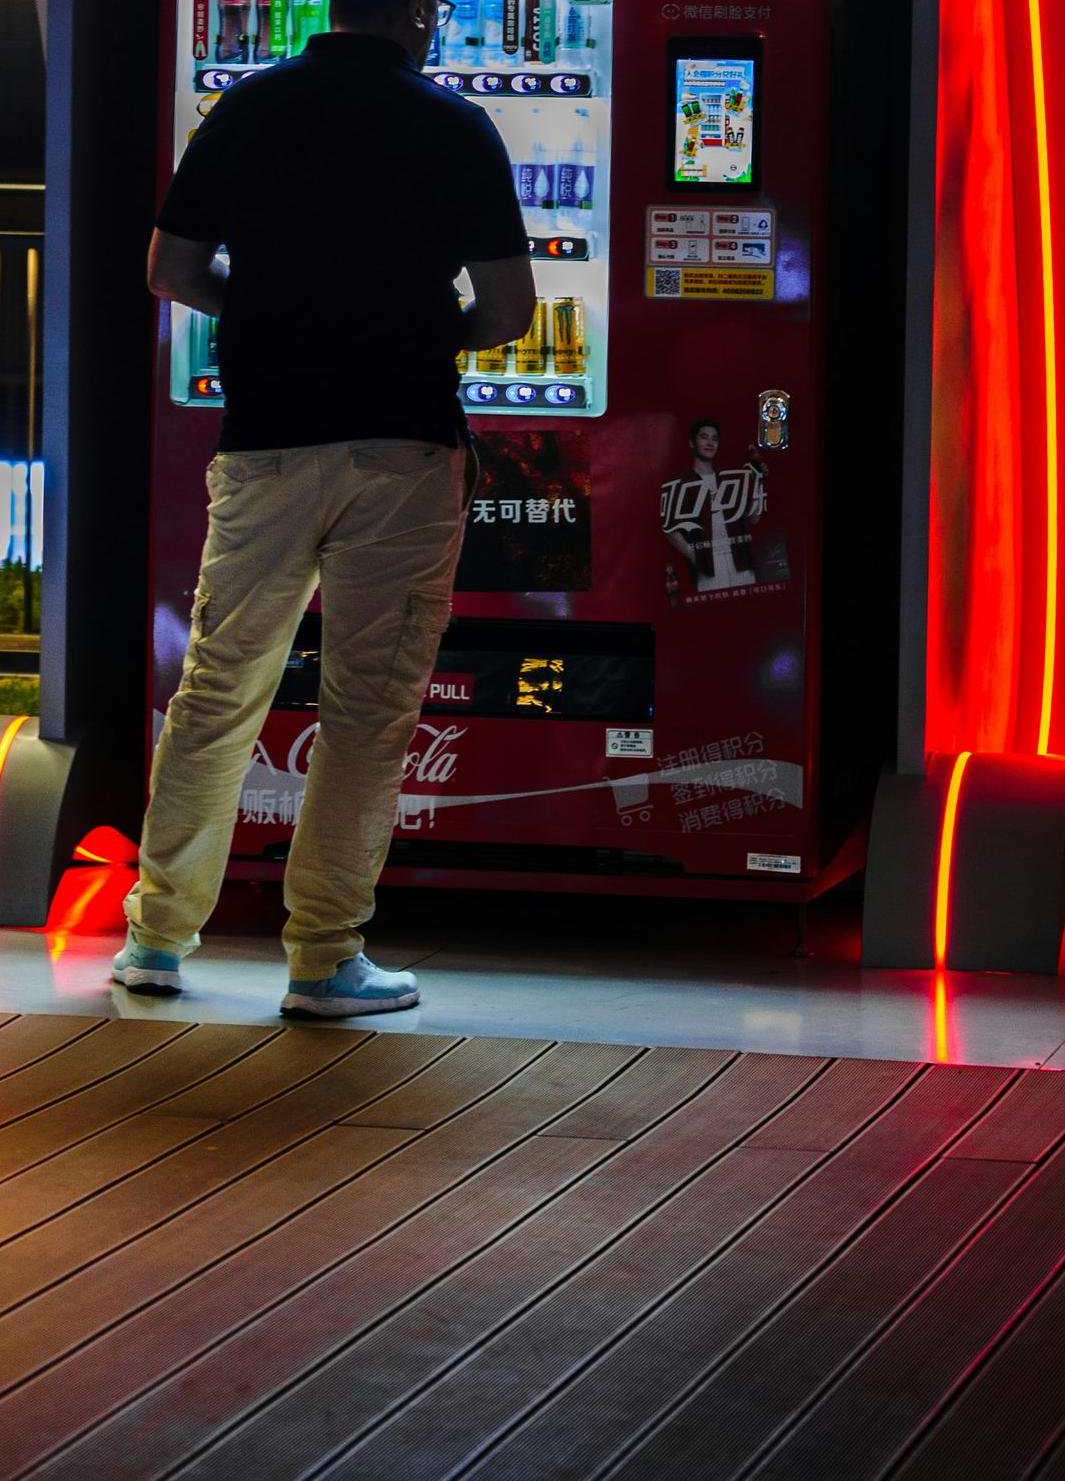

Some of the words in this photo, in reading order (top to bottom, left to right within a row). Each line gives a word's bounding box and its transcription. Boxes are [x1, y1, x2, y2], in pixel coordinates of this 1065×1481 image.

[683, 5, 771, 20] 微信刷脸支付
[472, 498, 577, 523] 无可替代
[659, 462, 769, 533] 可口可乐
[430, 683, 470, 699] PULL
[656, 731, 764, 777] 注册得积分
[670, 759, 778, 805] 签到得积分
[677, 788, 786, 835] 消费得积分
